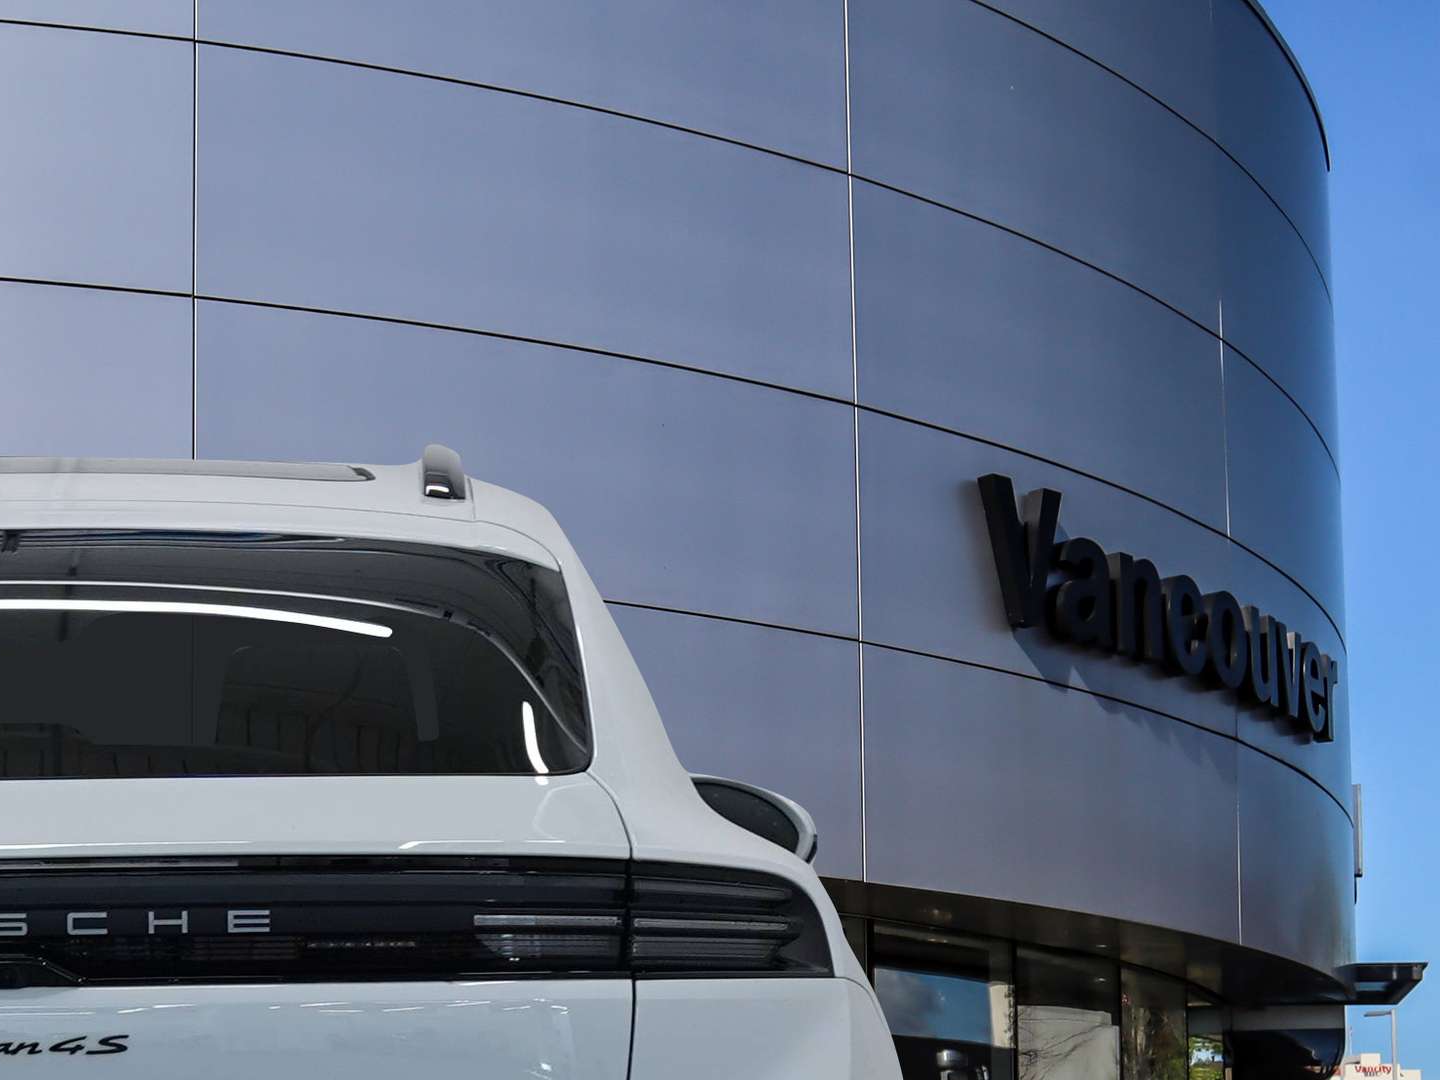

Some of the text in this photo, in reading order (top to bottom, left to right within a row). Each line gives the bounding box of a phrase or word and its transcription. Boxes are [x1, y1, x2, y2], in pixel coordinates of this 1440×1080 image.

[977, 473, 1338, 742] Vancouver
[49, 1035, 129, 1055] 4S
[1355, 1065, 1392, 1074] Vancity
